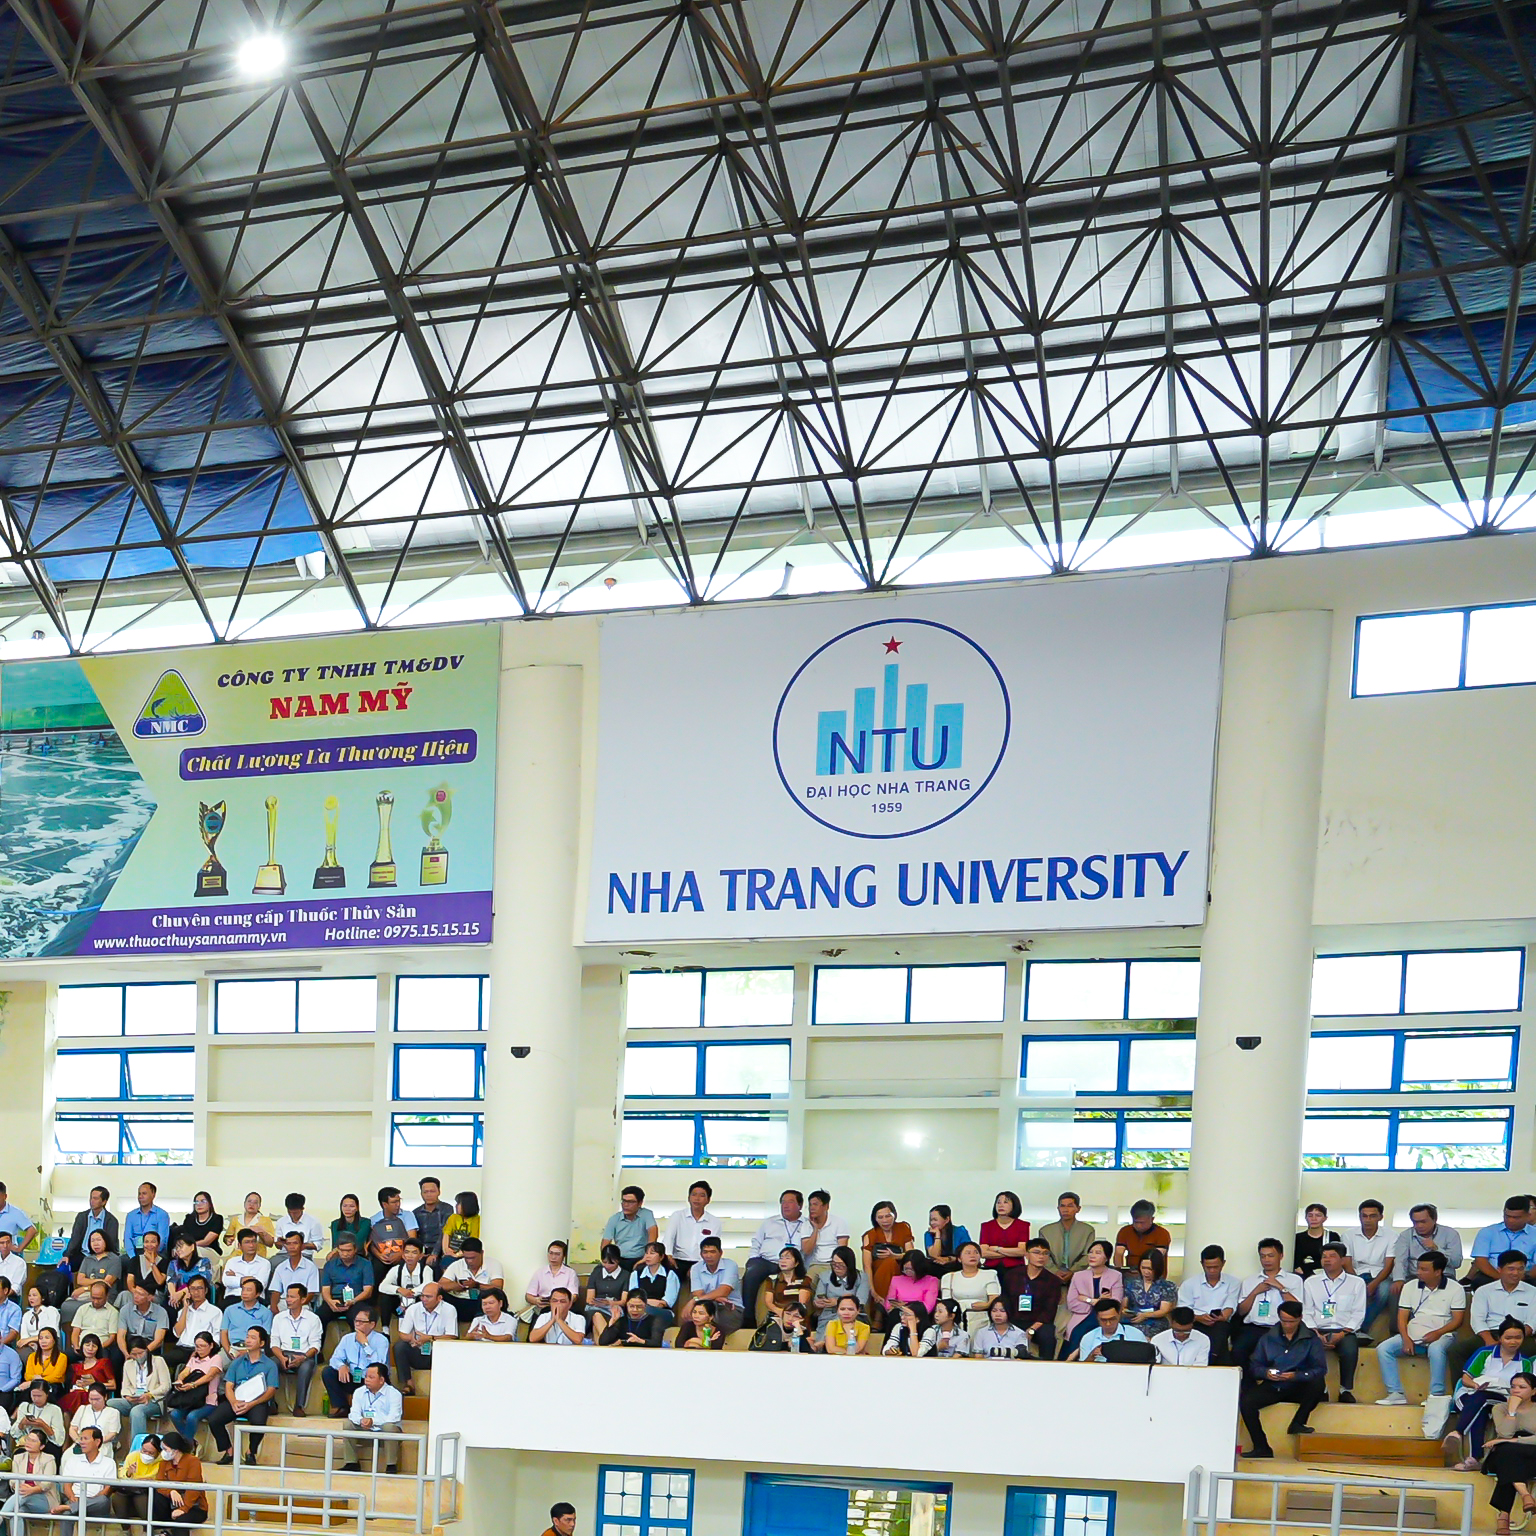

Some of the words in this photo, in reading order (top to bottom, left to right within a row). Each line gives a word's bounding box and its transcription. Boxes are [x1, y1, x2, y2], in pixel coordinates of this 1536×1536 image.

[217, 668, 275, 688] CÔNG
[282, 666, 311, 683] TY
[317, 662, 373, 681] TNHH
[383, 654, 465, 676] TM&DV
[269, 693, 349, 720] NAM
[358, 682, 412, 714] MỸ
[150, 719, 189, 735] NMC
[187, 752, 231, 773] Chất
[238, 747, 303, 772] Lượng
[306, 745, 332, 767] Là
[336, 741, 418, 767] Thương
[423, 738, 470, 761] Hiệu
[829, 725, 950, 776] NTU
[806, 782, 834, 800] ĐẠI
[837, 781, 871, 799] HỌC
[877, 780, 910, 795] NHA
[915, 778, 971, 793] TRANG
[871, 802, 903, 814] 1959
[608, 870, 705, 915] NHA
[719, 863, 877, 911] TRANG
[898, 849, 1190, 907] UNIVERSITY
[152, 911, 210, 929] Chuyên
[214, 911, 252, 929] cung
[255, 906, 284, 927] cấp
[288, 905, 338, 923] Thuốc
[386, 902, 416, 920] Sản
[94, 931, 287, 952] www.thuocthuysannammy.vn
[325, 925, 381, 942] Hotline:
[384, 922, 480, 940] 0975.15.15.15
